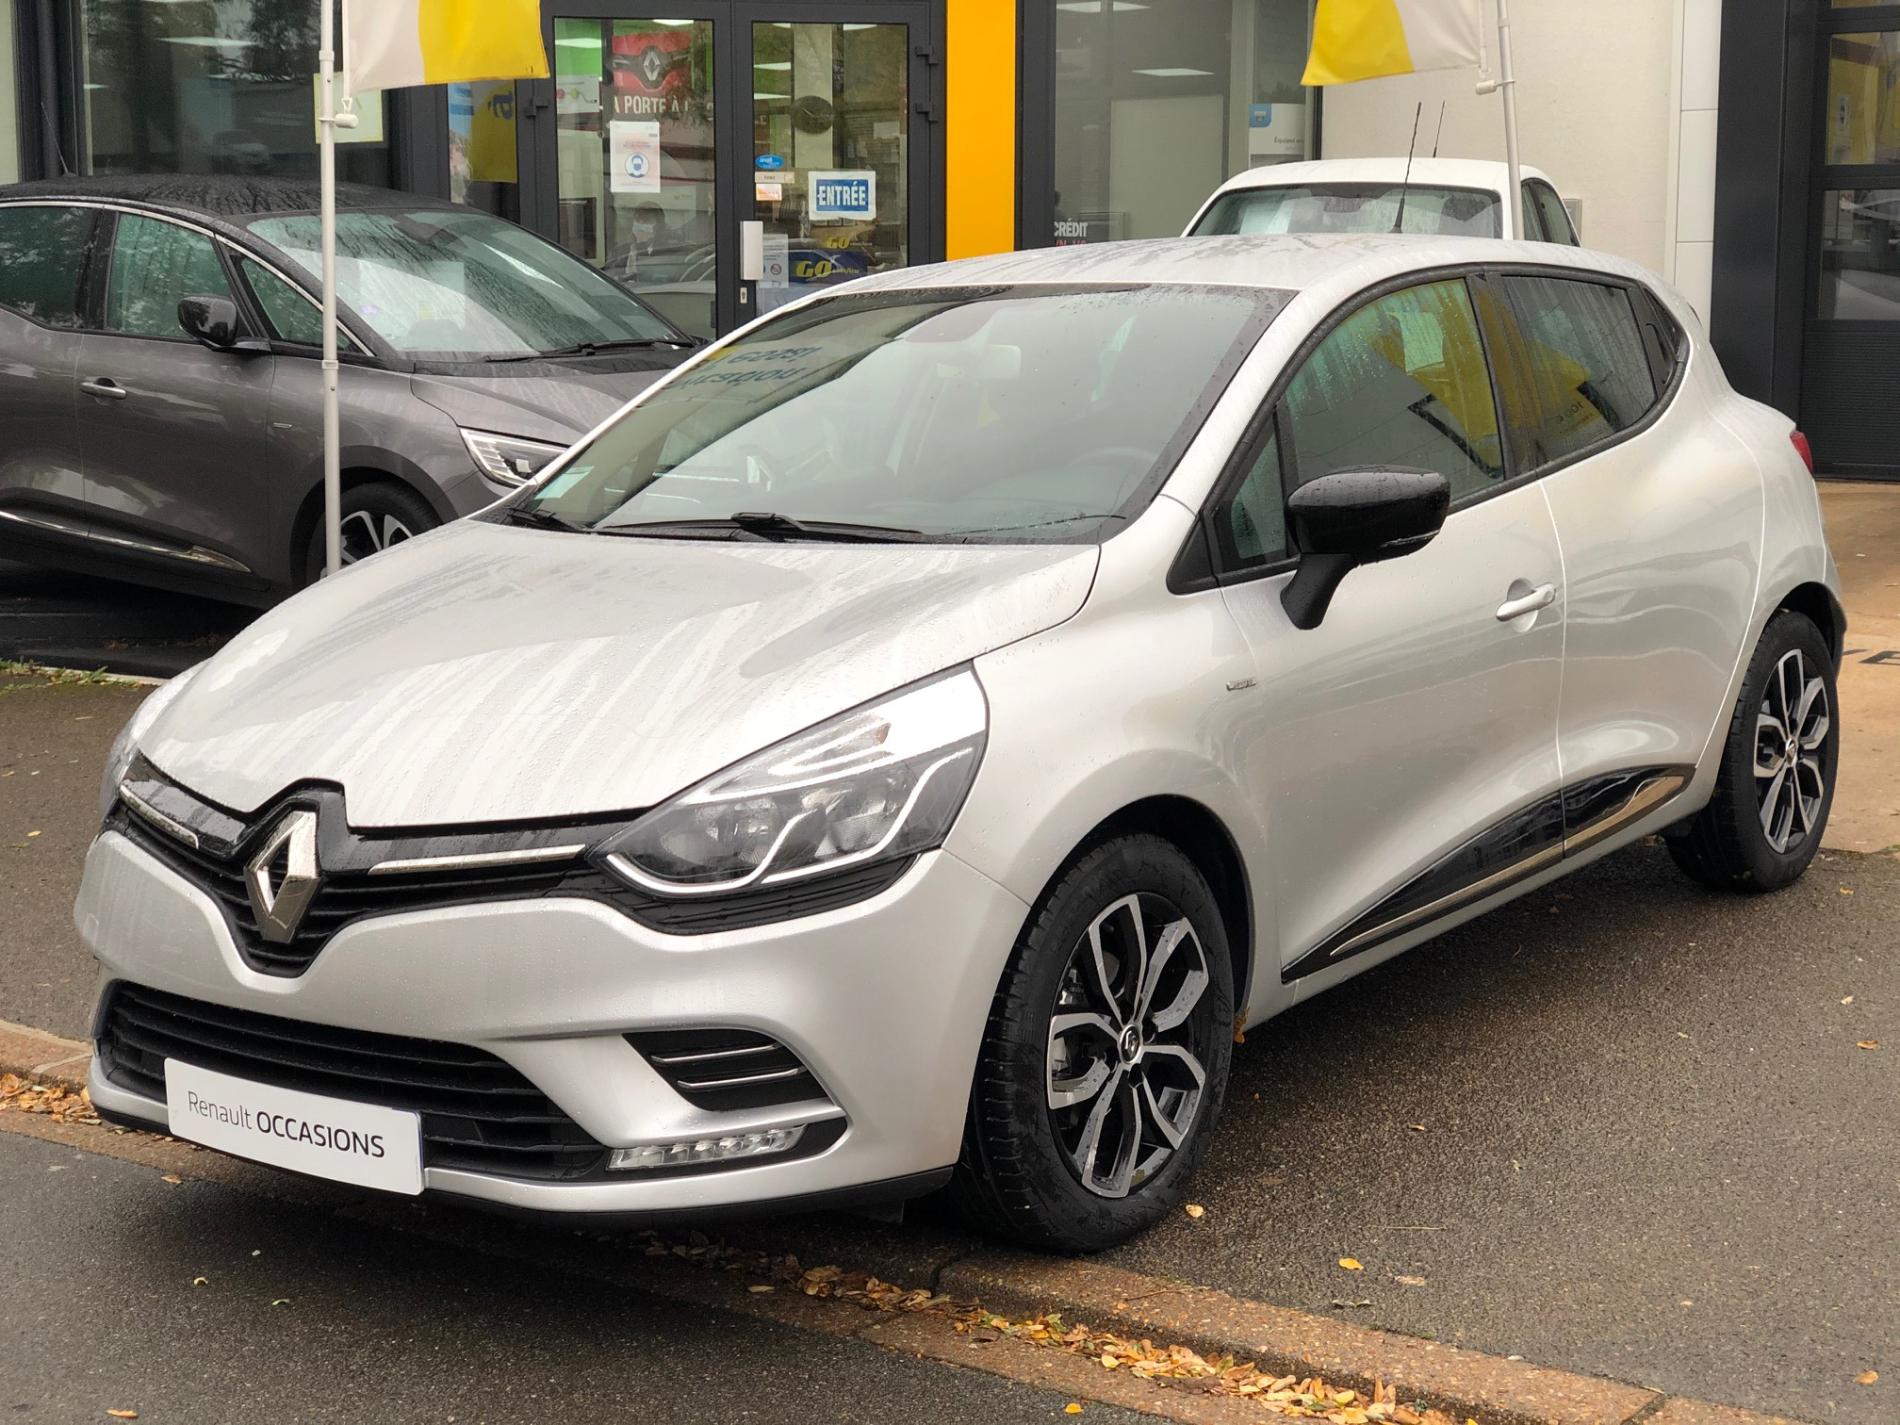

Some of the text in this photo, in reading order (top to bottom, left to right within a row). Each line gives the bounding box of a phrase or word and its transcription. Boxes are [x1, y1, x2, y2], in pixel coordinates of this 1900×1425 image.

[624, 95, 667, 114] PORTE
[817, 180, 866, 206] ENTRÉE
[1053, 217, 1089, 237] CRÉDIT
[795, 260, 833, 279] GO
[187, 1090, 385, 1158] Renault OCCASIONS
